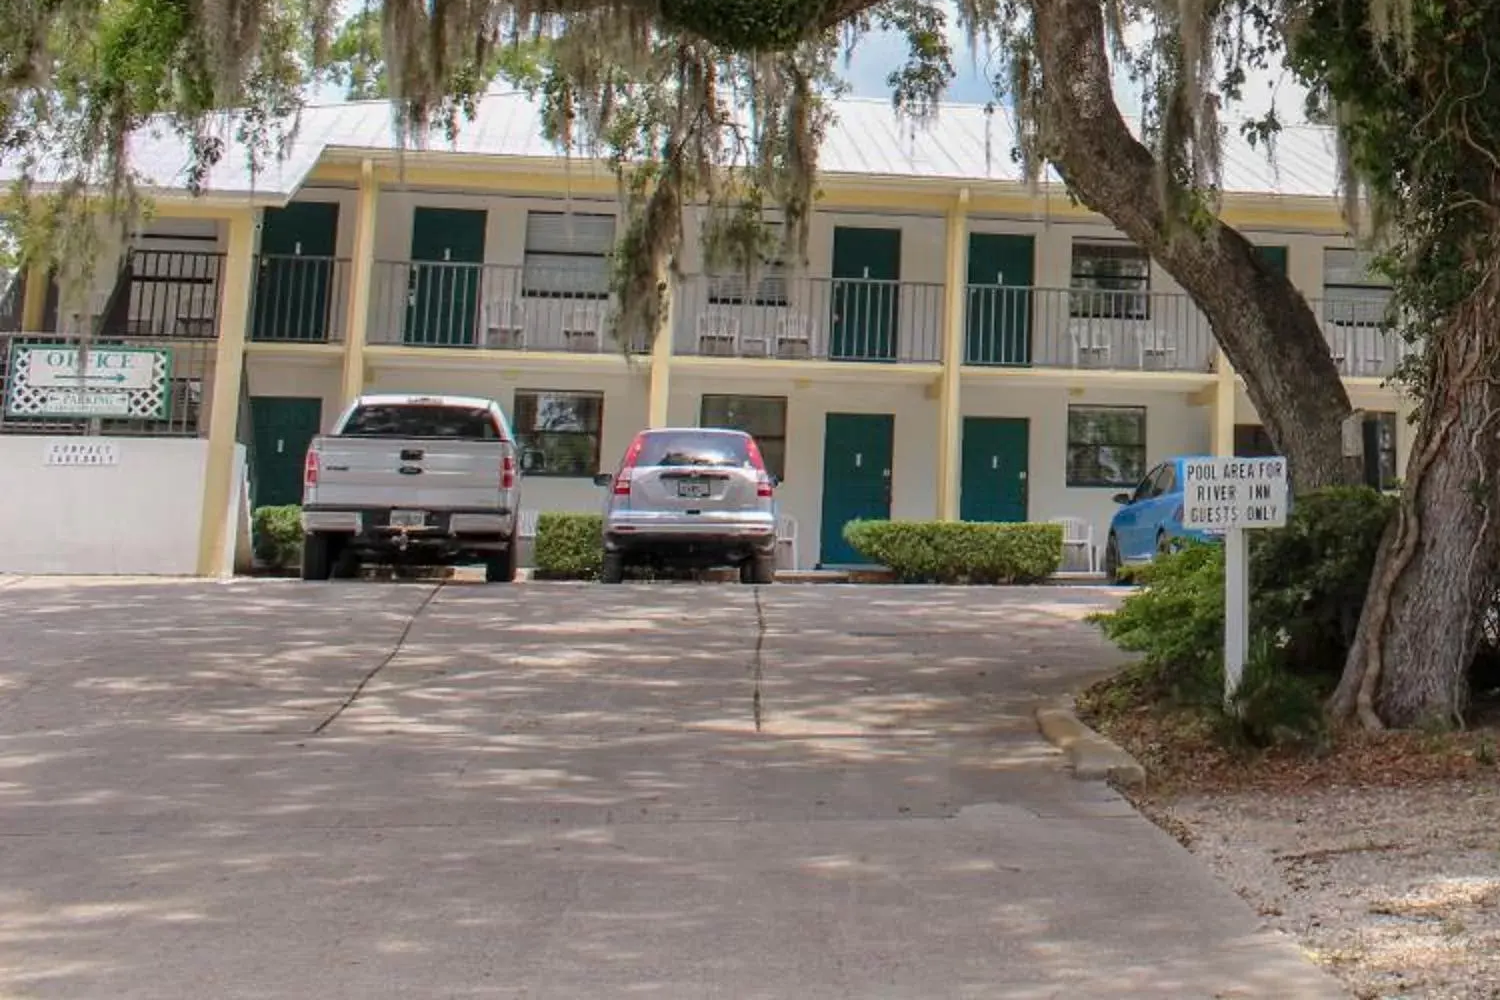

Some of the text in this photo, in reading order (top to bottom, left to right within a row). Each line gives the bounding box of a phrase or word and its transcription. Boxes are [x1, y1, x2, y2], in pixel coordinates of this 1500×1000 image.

[1187, 462, 1282, 480] POOL AREA FOR
[1197, 484, 1271, 501] RIVER INN
[1191, 505, 1277, 522] GUESTS ONLY
